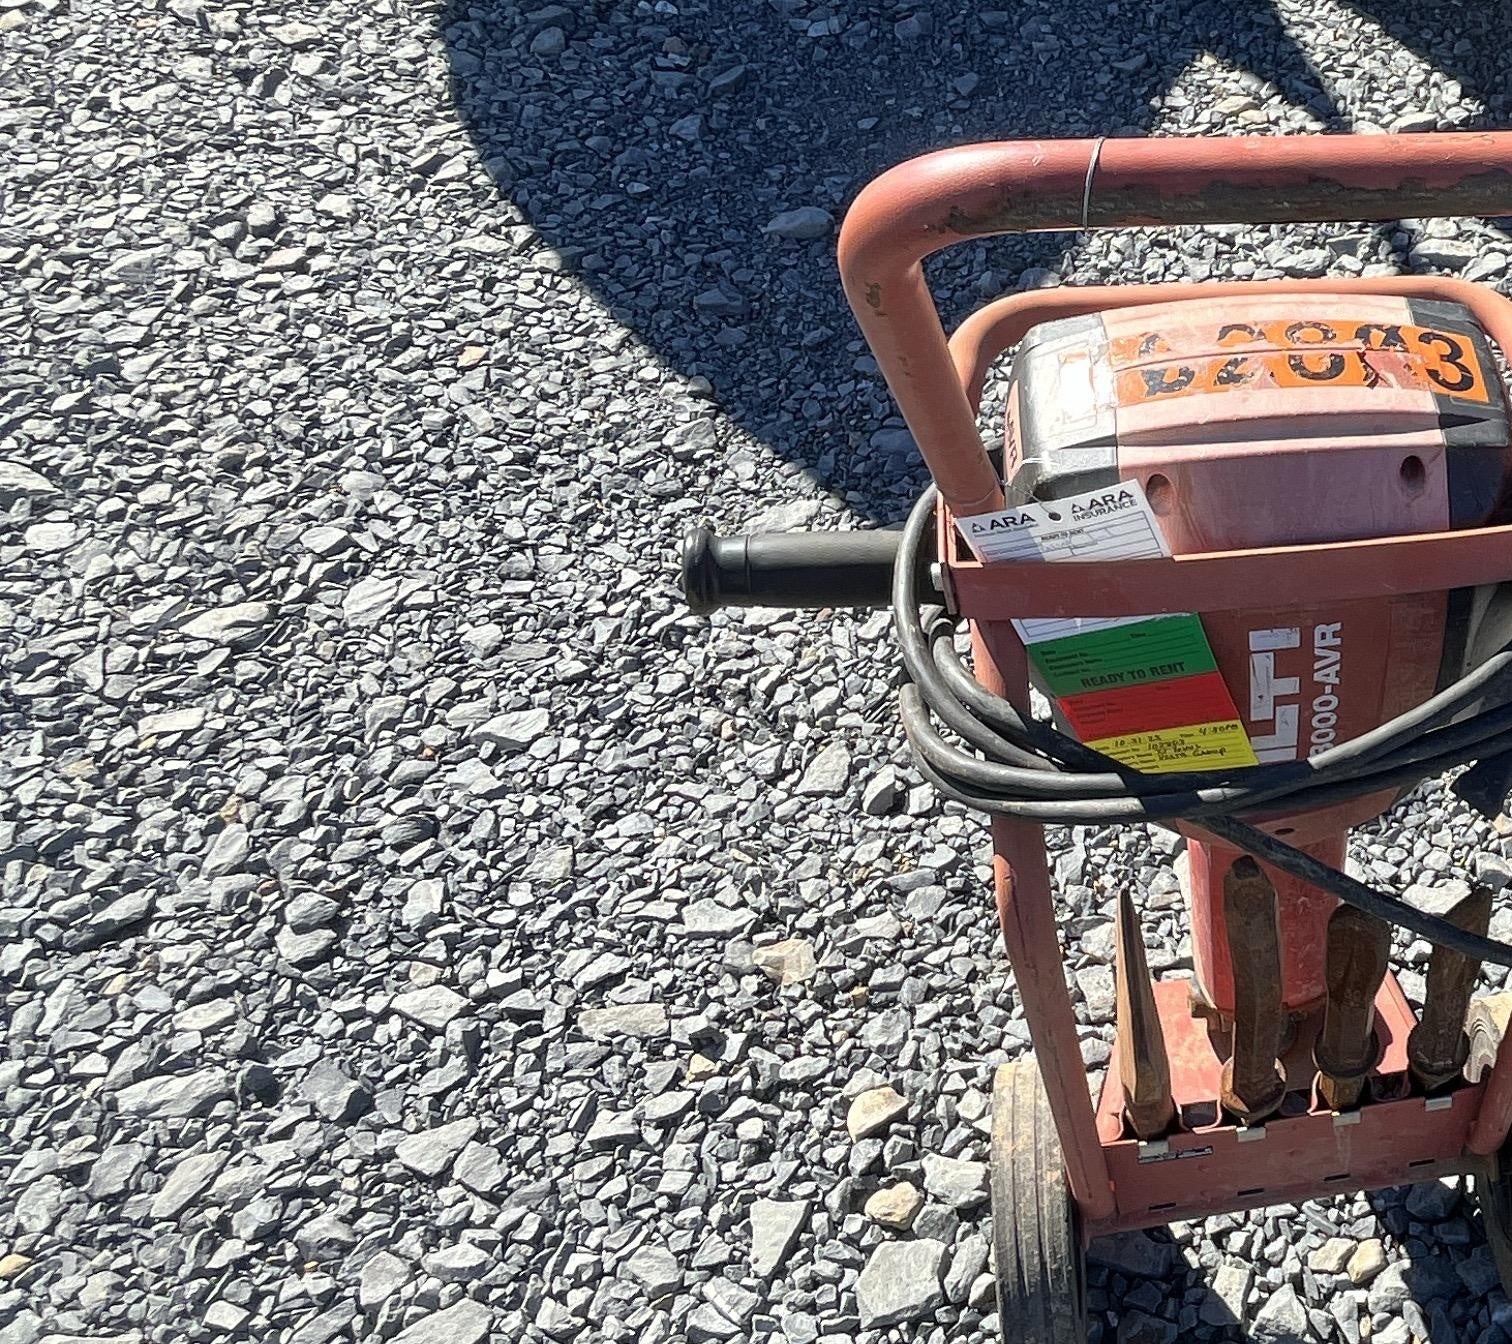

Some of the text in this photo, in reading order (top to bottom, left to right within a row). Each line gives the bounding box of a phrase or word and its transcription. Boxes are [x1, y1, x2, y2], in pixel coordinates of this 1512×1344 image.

[1072, 498, 1138, 522] INSURANCE
[1088, 489, 1133, 509] ARA
[990, 513, 1036, 530] ARA
[1080, 672, 1126, 689] READY
[1127, 668, 1147, 681] TO
[1149, 661, 1187, 677] RENT
[1248, 627, 1300, 763] ILTI
